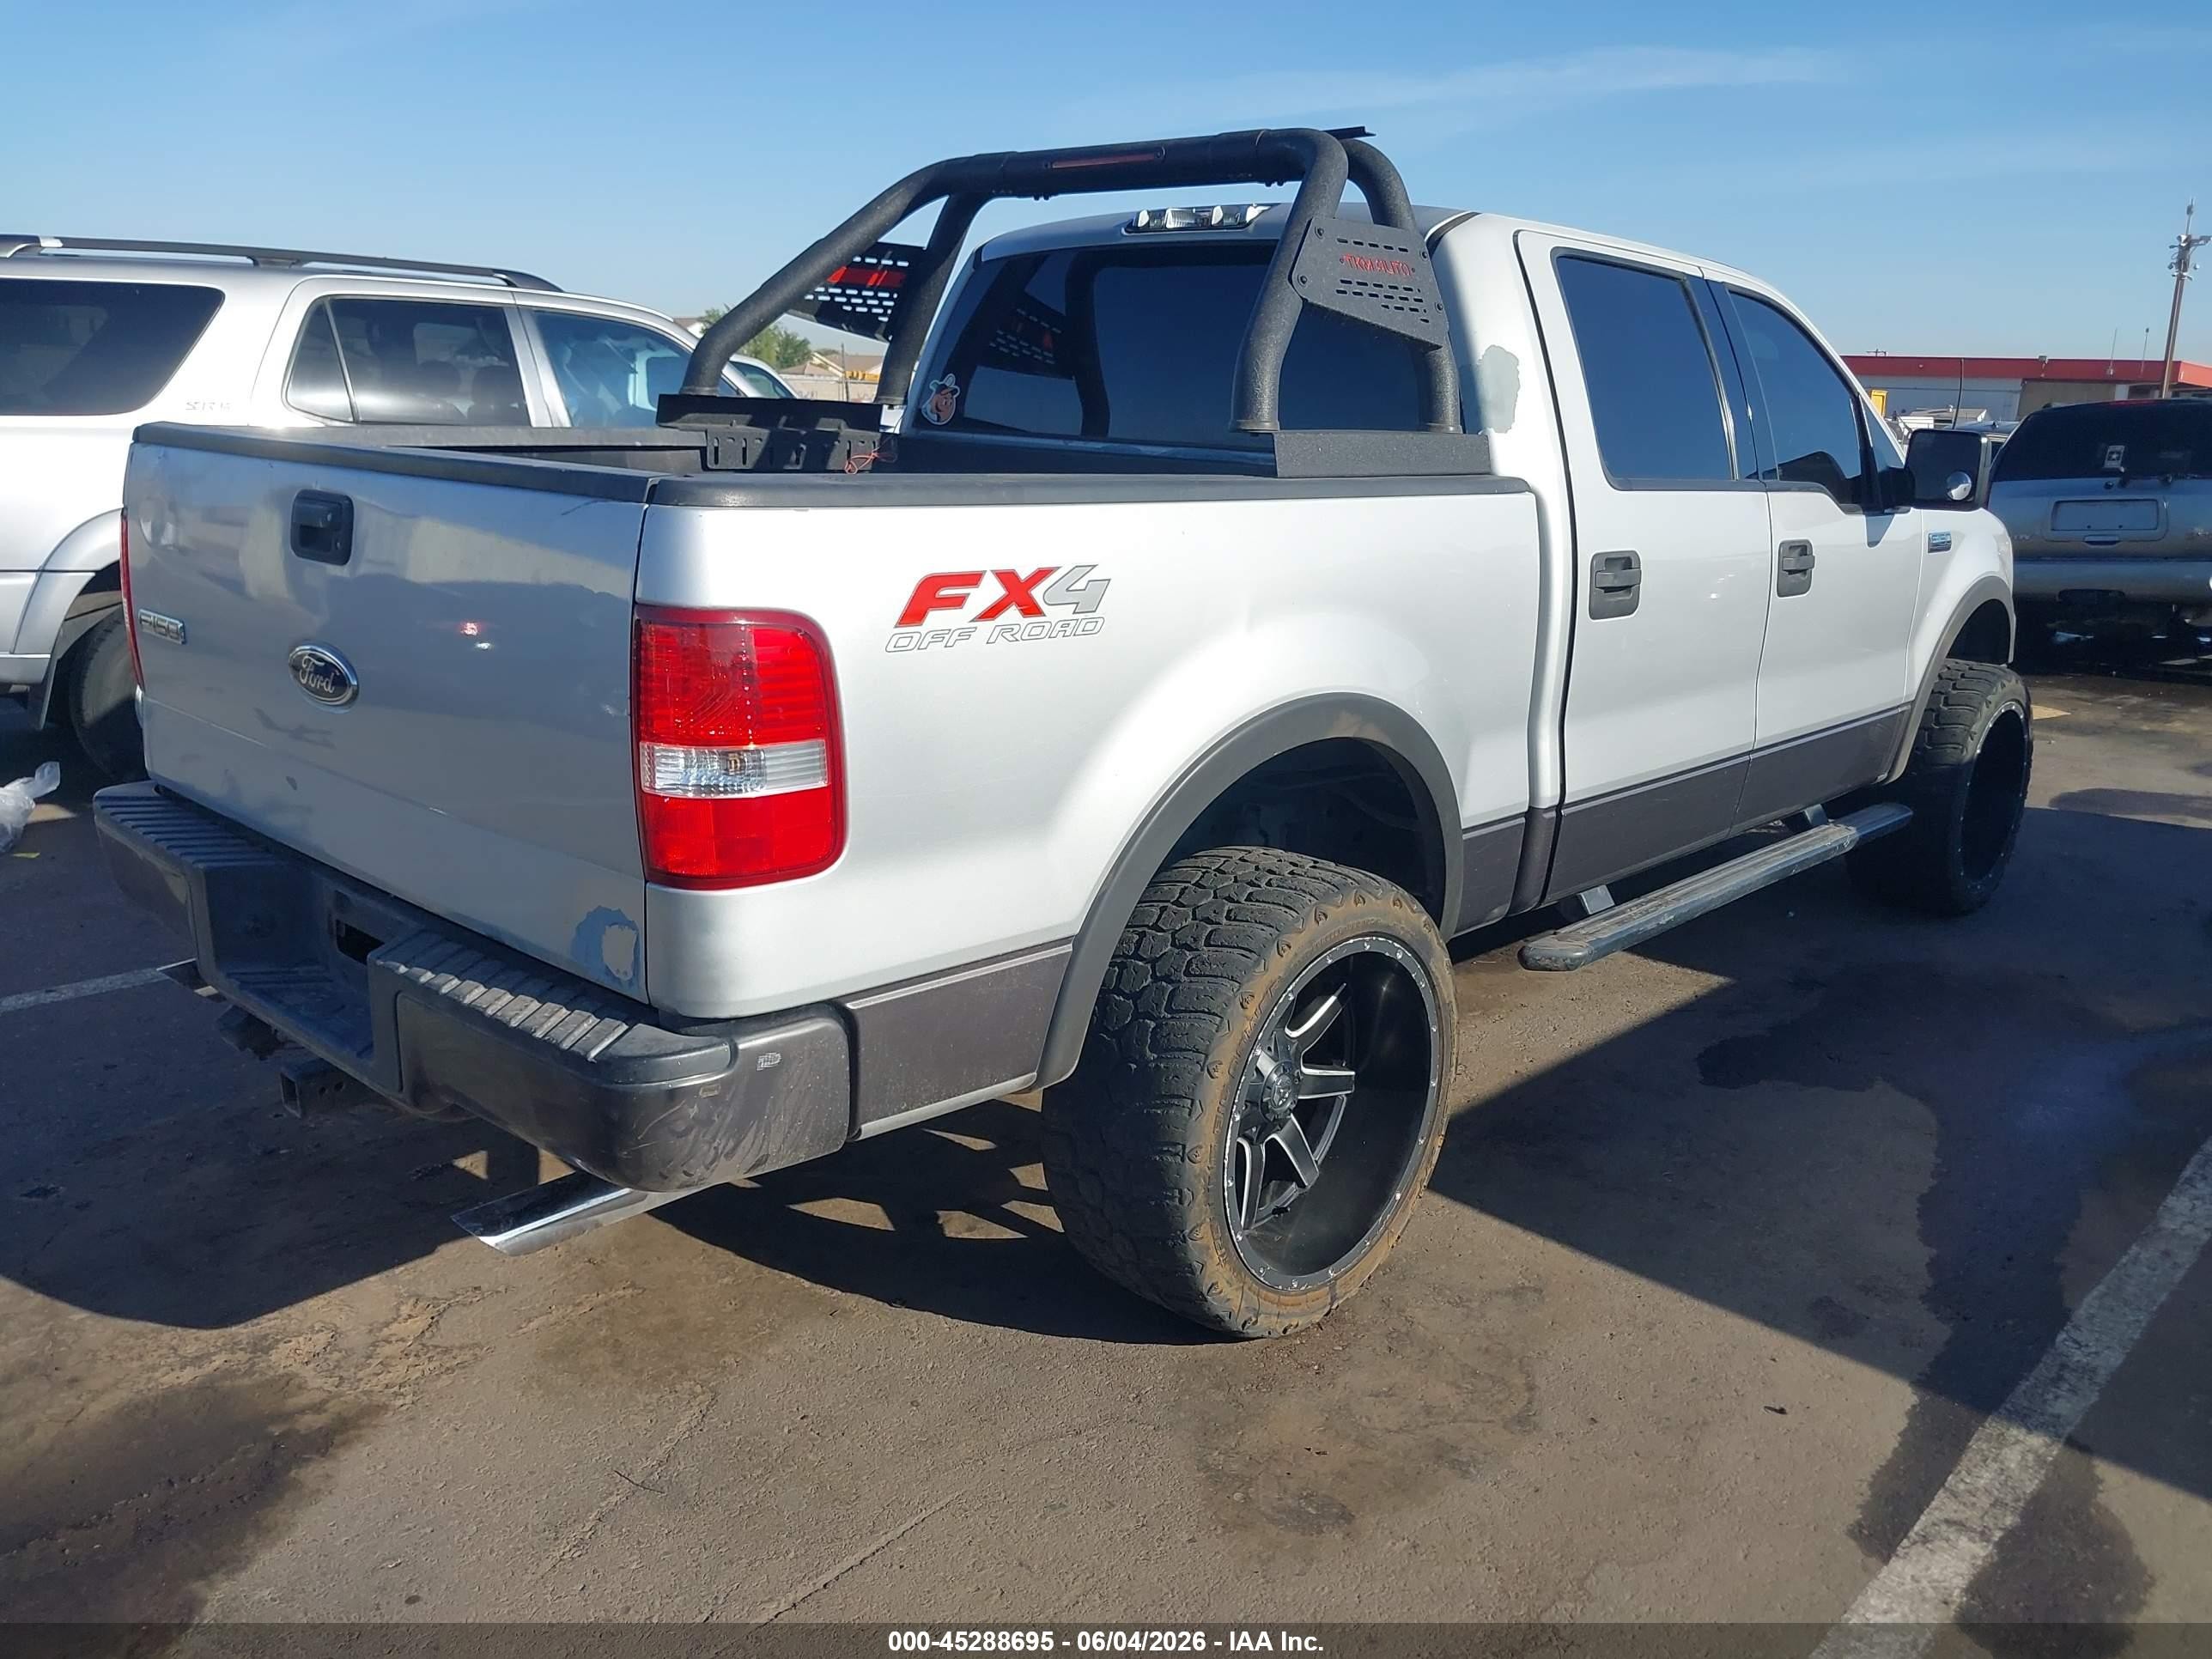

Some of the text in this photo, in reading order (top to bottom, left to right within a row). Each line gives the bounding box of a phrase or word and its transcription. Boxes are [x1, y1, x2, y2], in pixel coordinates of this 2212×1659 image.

[894, 564, 1111, 628] FX4
[885, 617, 1105, 653] OFF ROAD
[299, 654, 335, 694] Ford
